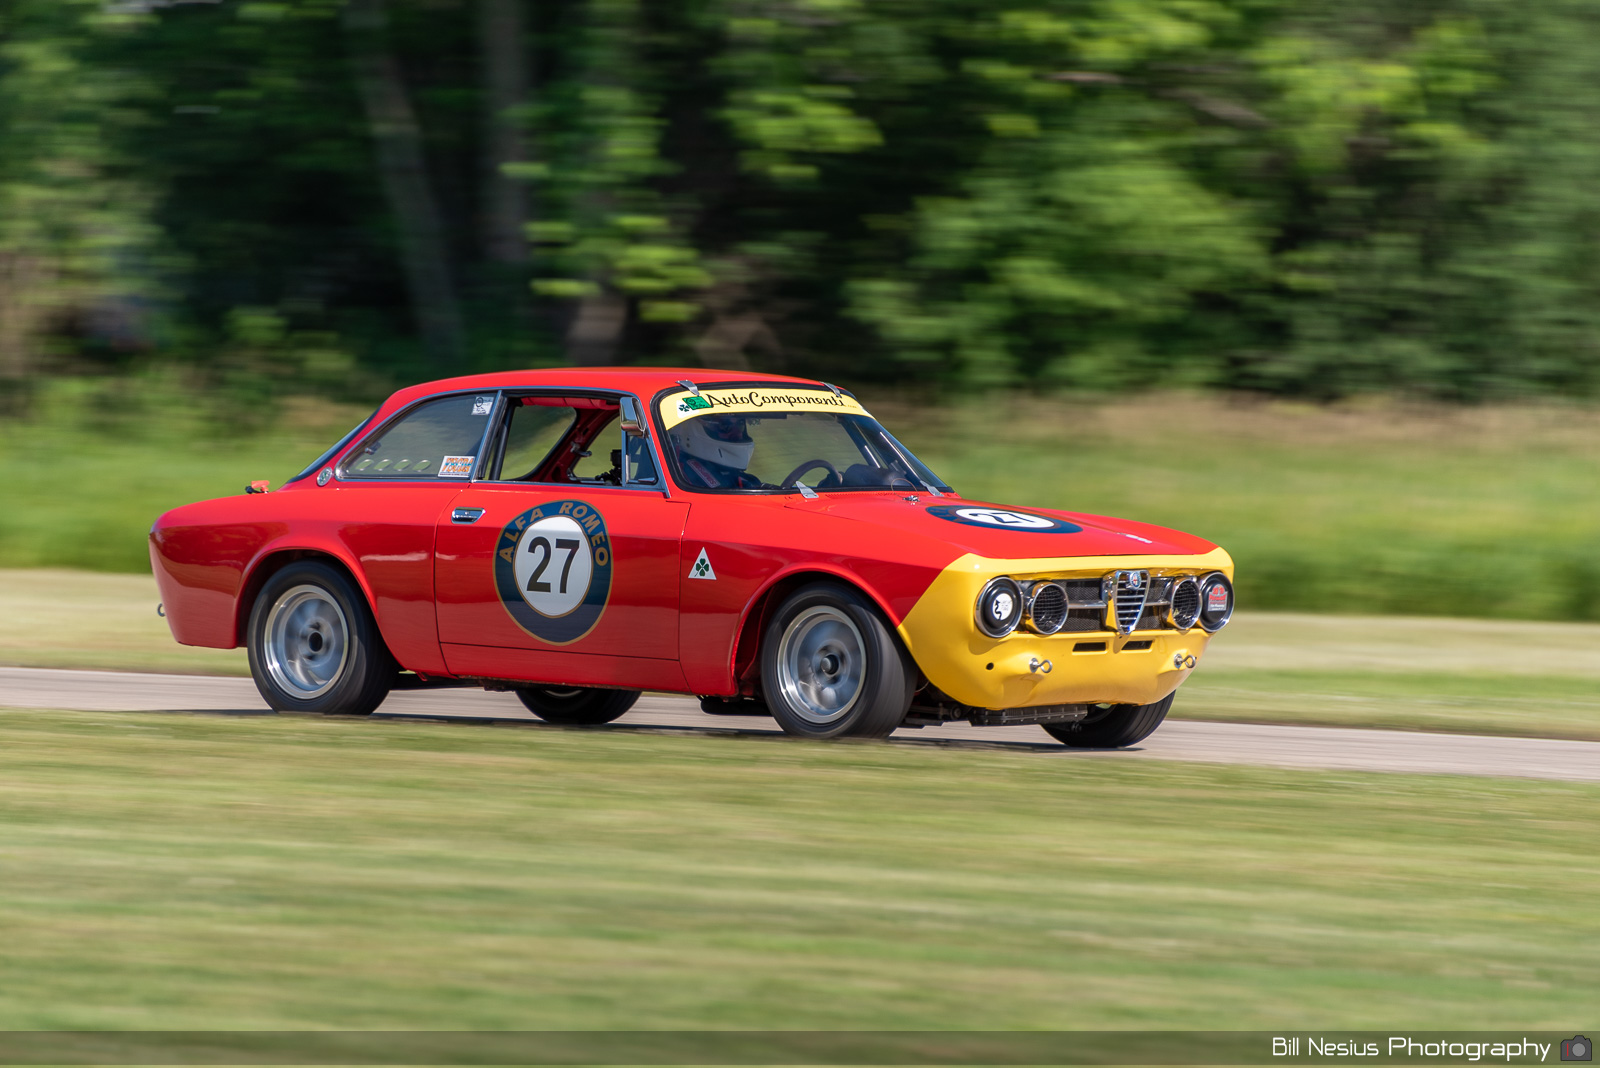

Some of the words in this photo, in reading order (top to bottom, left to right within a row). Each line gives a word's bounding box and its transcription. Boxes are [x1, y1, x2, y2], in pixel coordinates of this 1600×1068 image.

[499, 508, 544, 563] ALFA
[559, 502, 608, 566] ROMEO
[968, 512, 1036, 523] 27
[527, 536, 580, 594] 27
